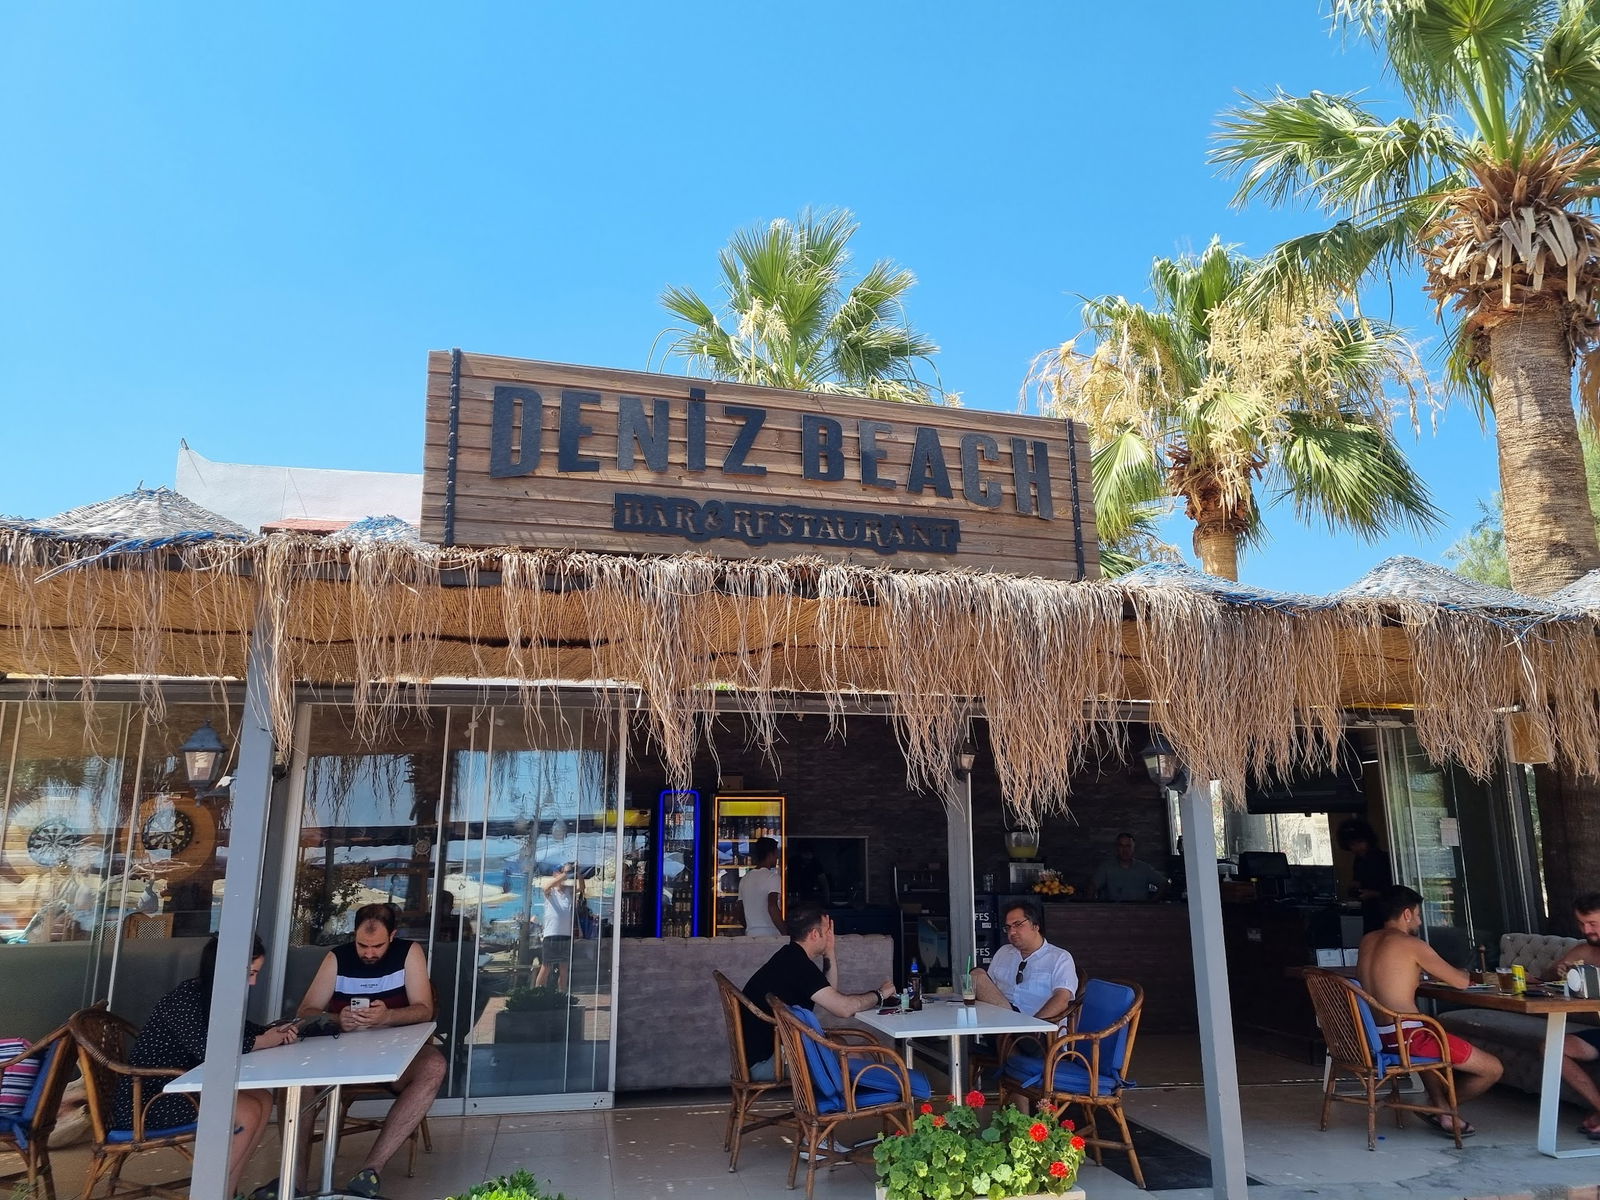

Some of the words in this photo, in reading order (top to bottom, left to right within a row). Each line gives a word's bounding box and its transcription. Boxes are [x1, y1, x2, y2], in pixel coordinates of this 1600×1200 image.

[489, 386, 767, 479] DENİZ
[802, 414, 1054, 521] BEACH
[733, 509, 954, 547] RESTAURANT
[975, 912, 990, 921] FES
[975, 947, 990, 957] FES
